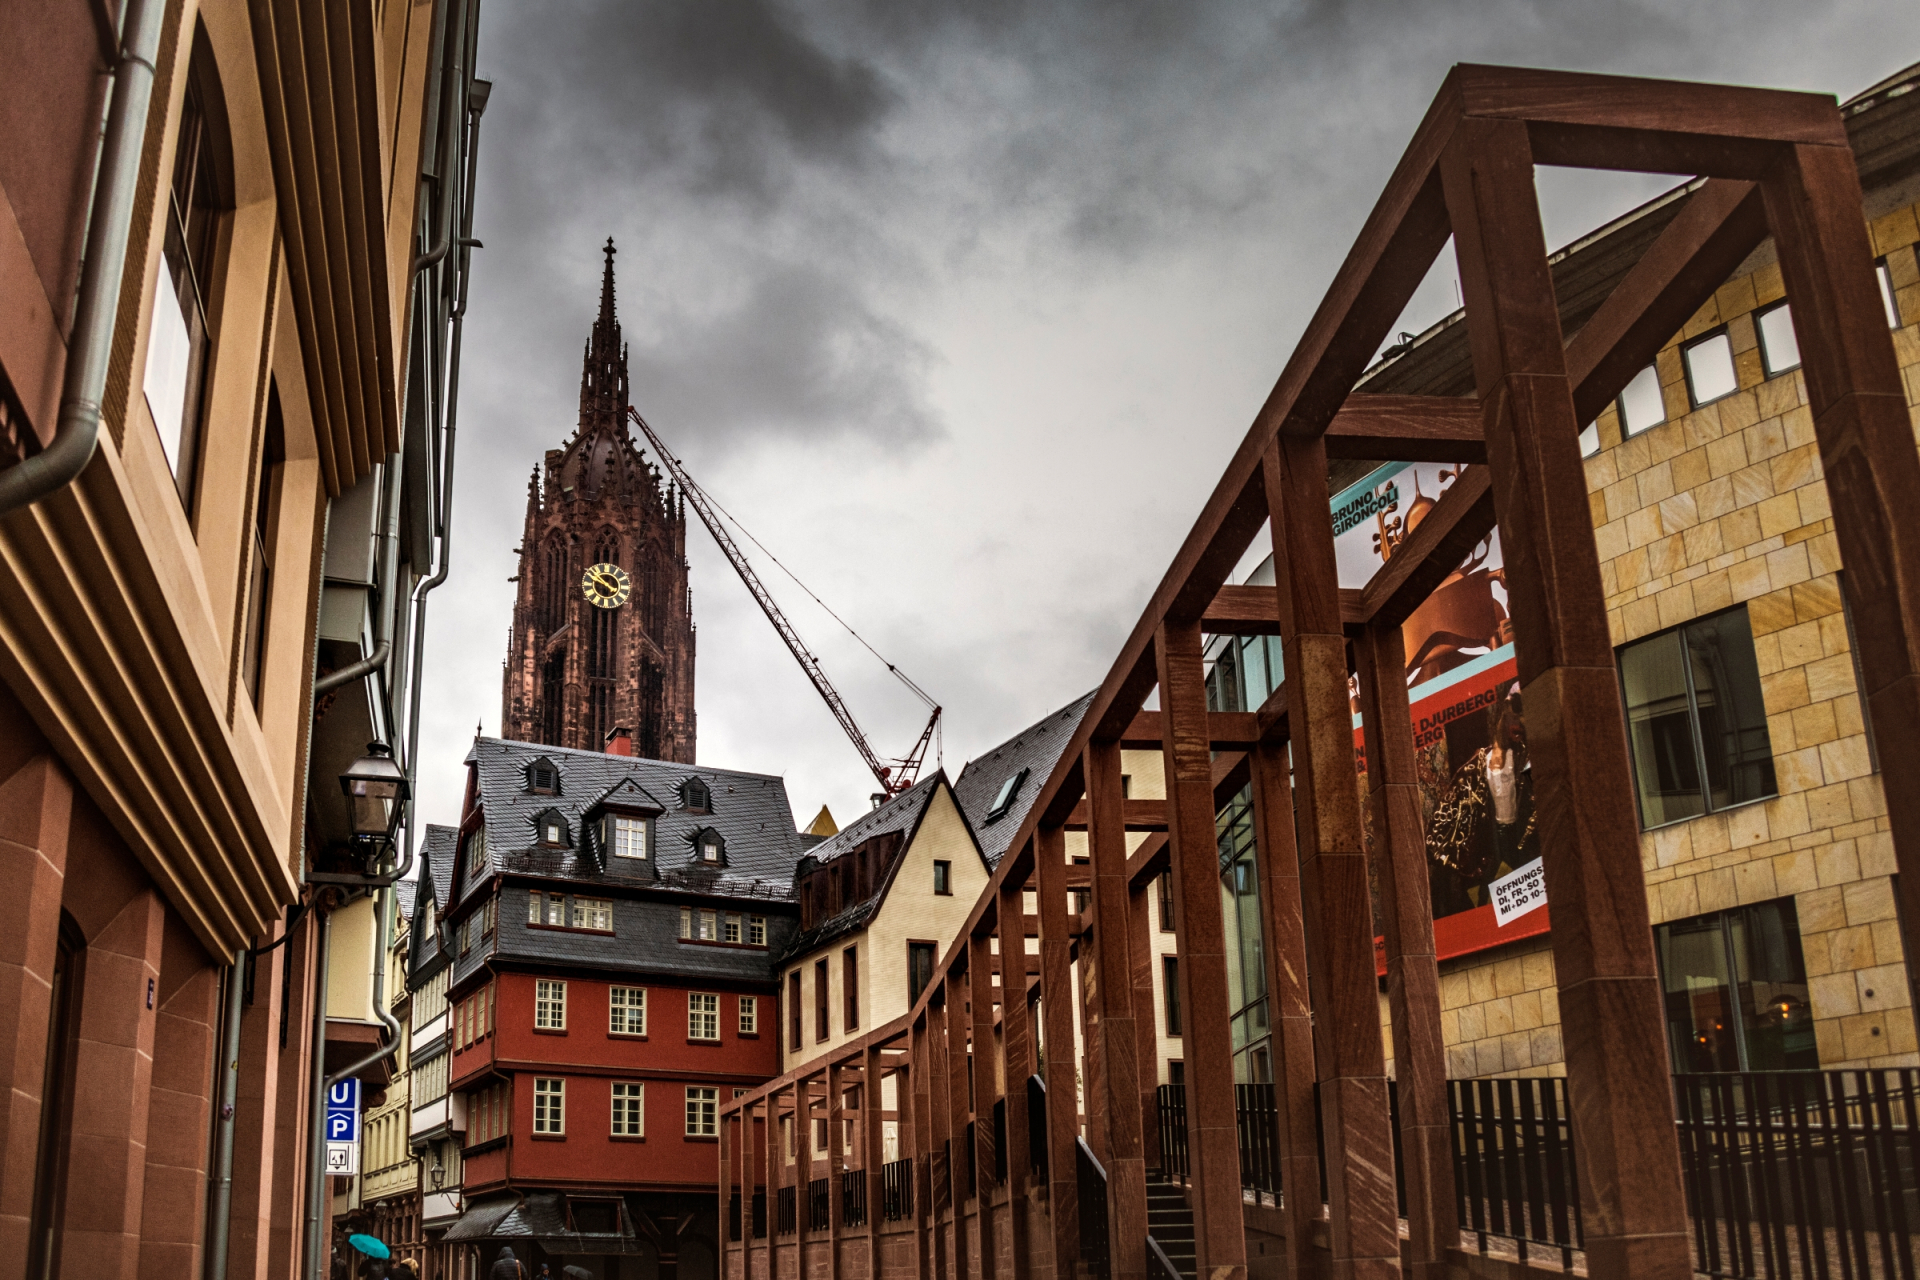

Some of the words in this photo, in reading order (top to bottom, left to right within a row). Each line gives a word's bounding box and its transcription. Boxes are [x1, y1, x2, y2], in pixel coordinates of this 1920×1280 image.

[1332, 491, 1373, 524] BRUNO
[1333, 487, 1399, 537] GIRONCOLI
[1420, 689, 1495, 732] DJURBERG
[1416, 727, 1443, 748] ERG
[1496, 866, 1544, 896] ÖFFNUNGS
[331, 1083, 349, 1104] U
[332, 1119, 348, 1138] P
